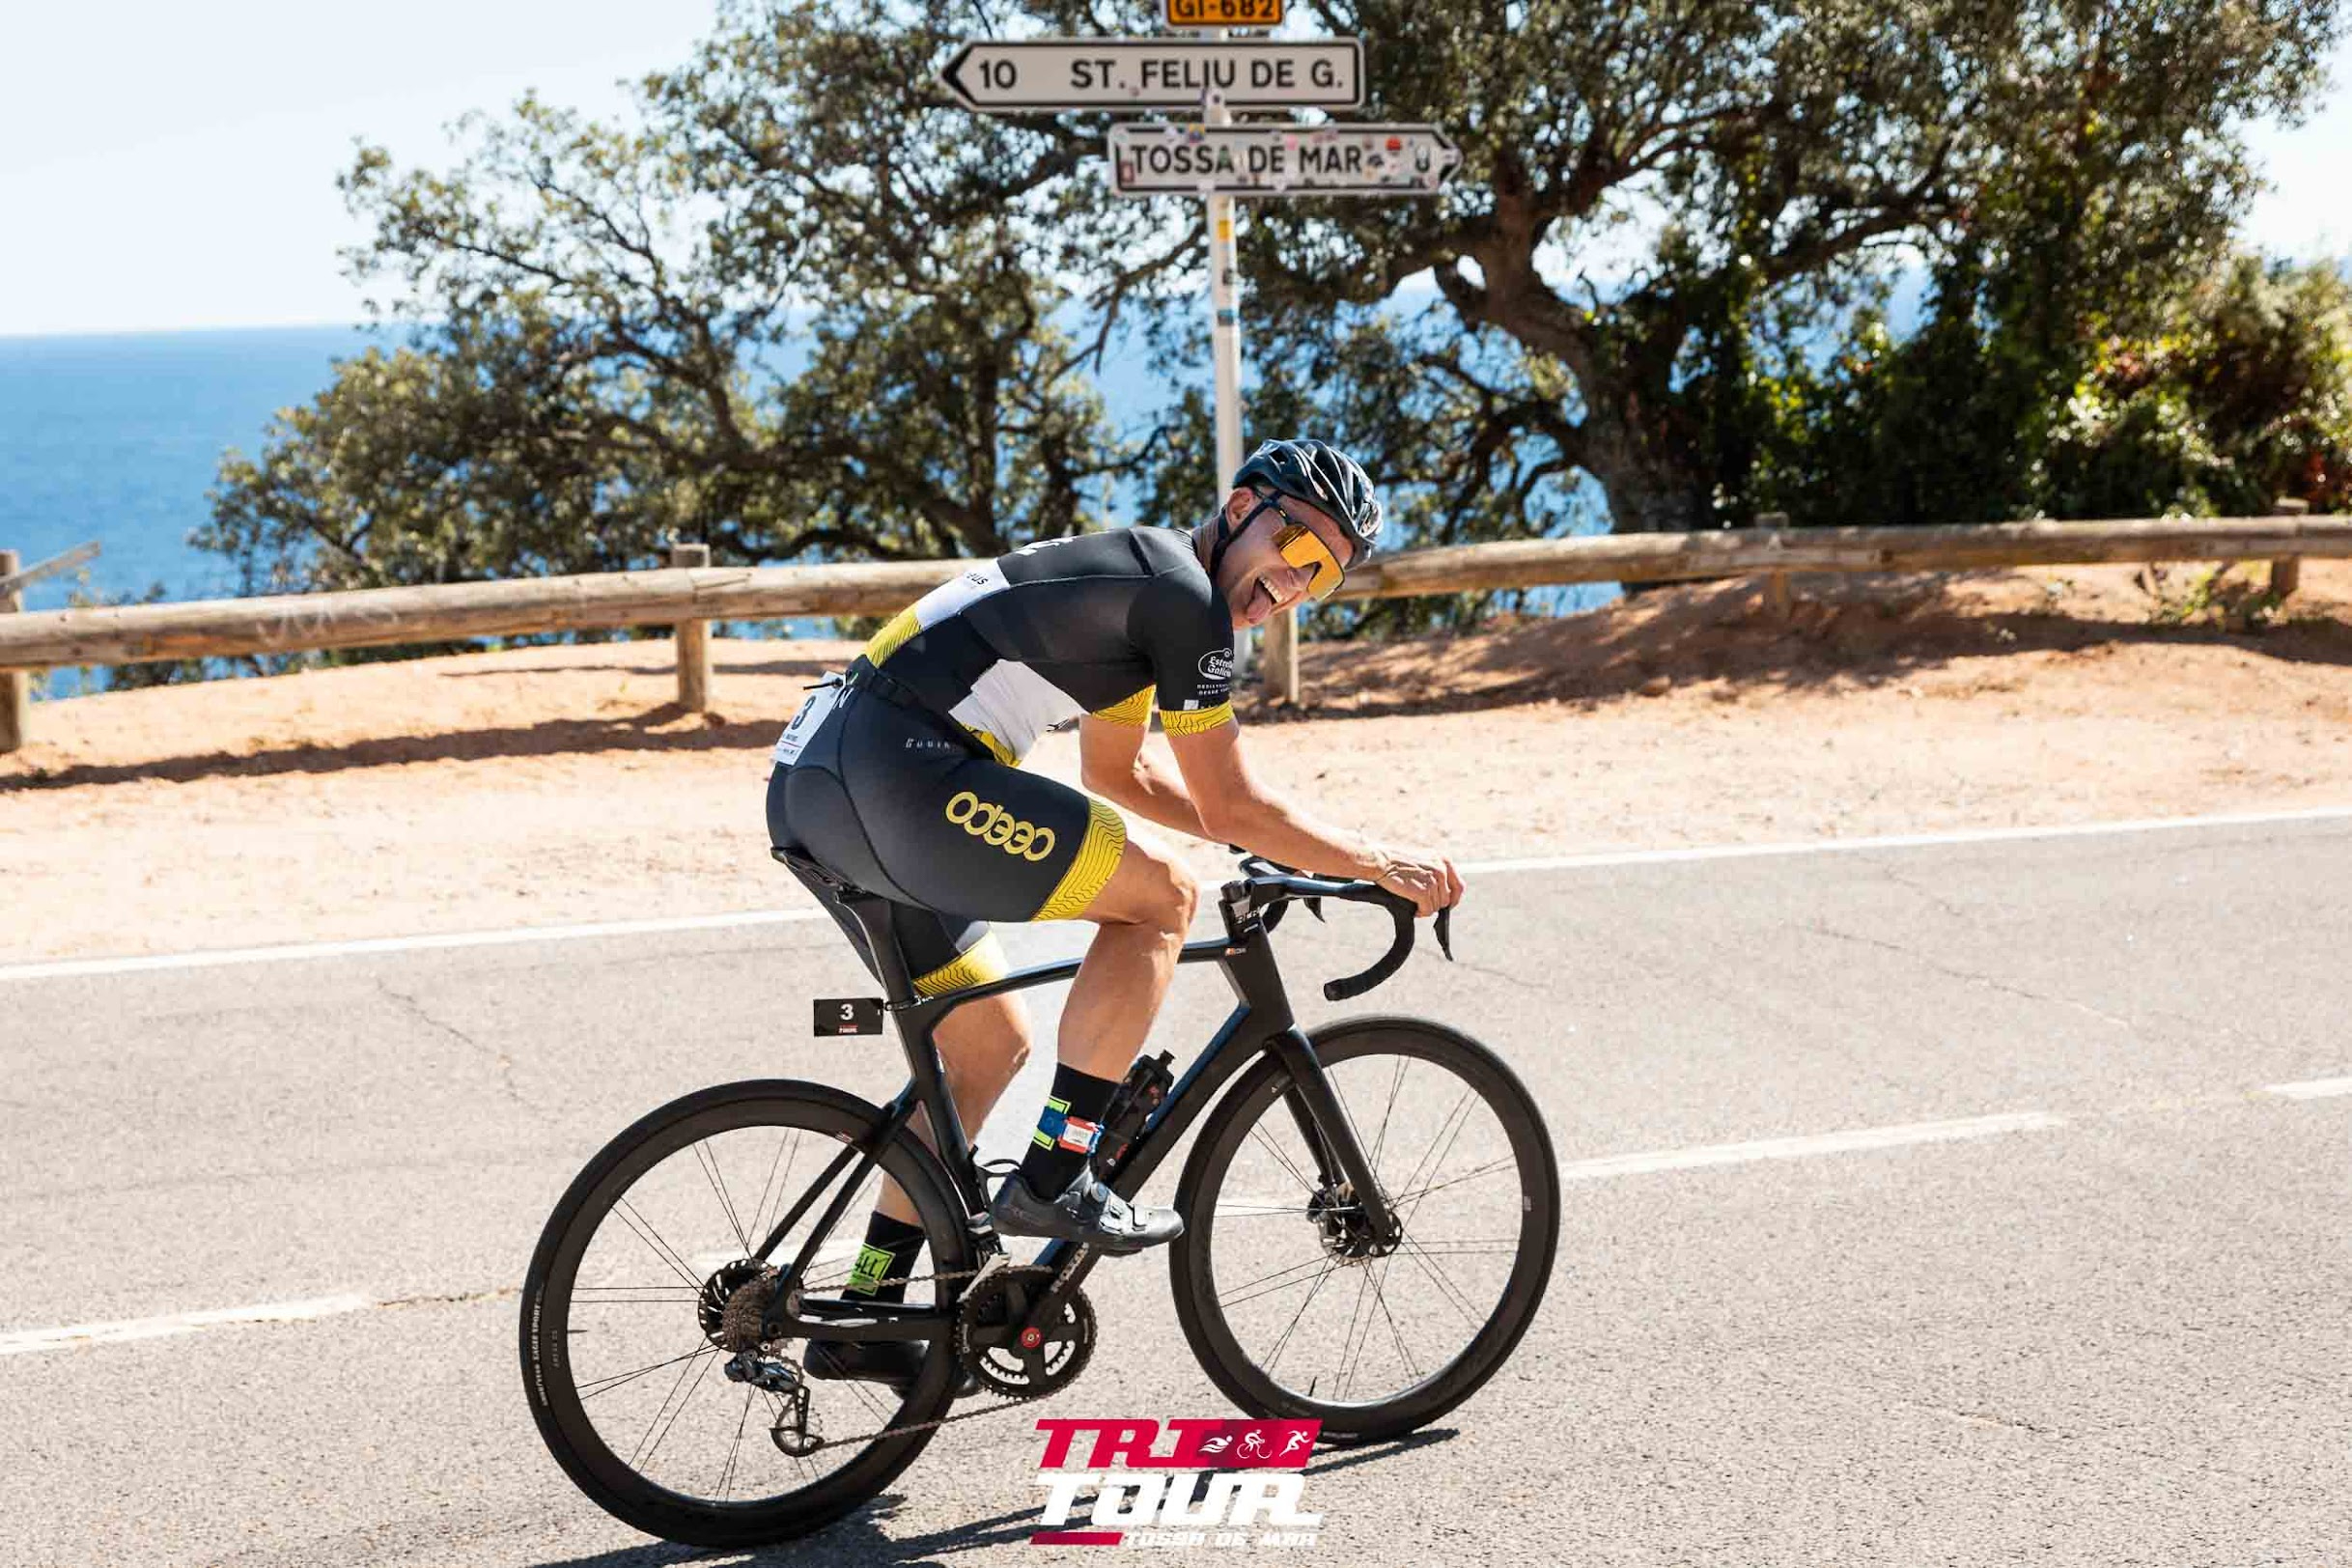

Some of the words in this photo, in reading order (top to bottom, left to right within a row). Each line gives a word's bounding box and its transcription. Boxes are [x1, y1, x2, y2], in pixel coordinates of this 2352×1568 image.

[1175, 0, 1274, 17] GI-682
[979, 59, 1017, 89] 10
[1071, 59, 1125, 89] ST.
[1140, 59, 1235, 89] FELIU
[1250, 59, 1295, 89] DE
[1310, 59, 1343, 89] G.
[1131, 145, 1235, 174] TOSSA
[1248, 145, 1285, 174] DE
[1299, 145, 1362, 174] MAR
[791, 695, 817, 730] 3
[839, 1003, 854, 1021] 3
